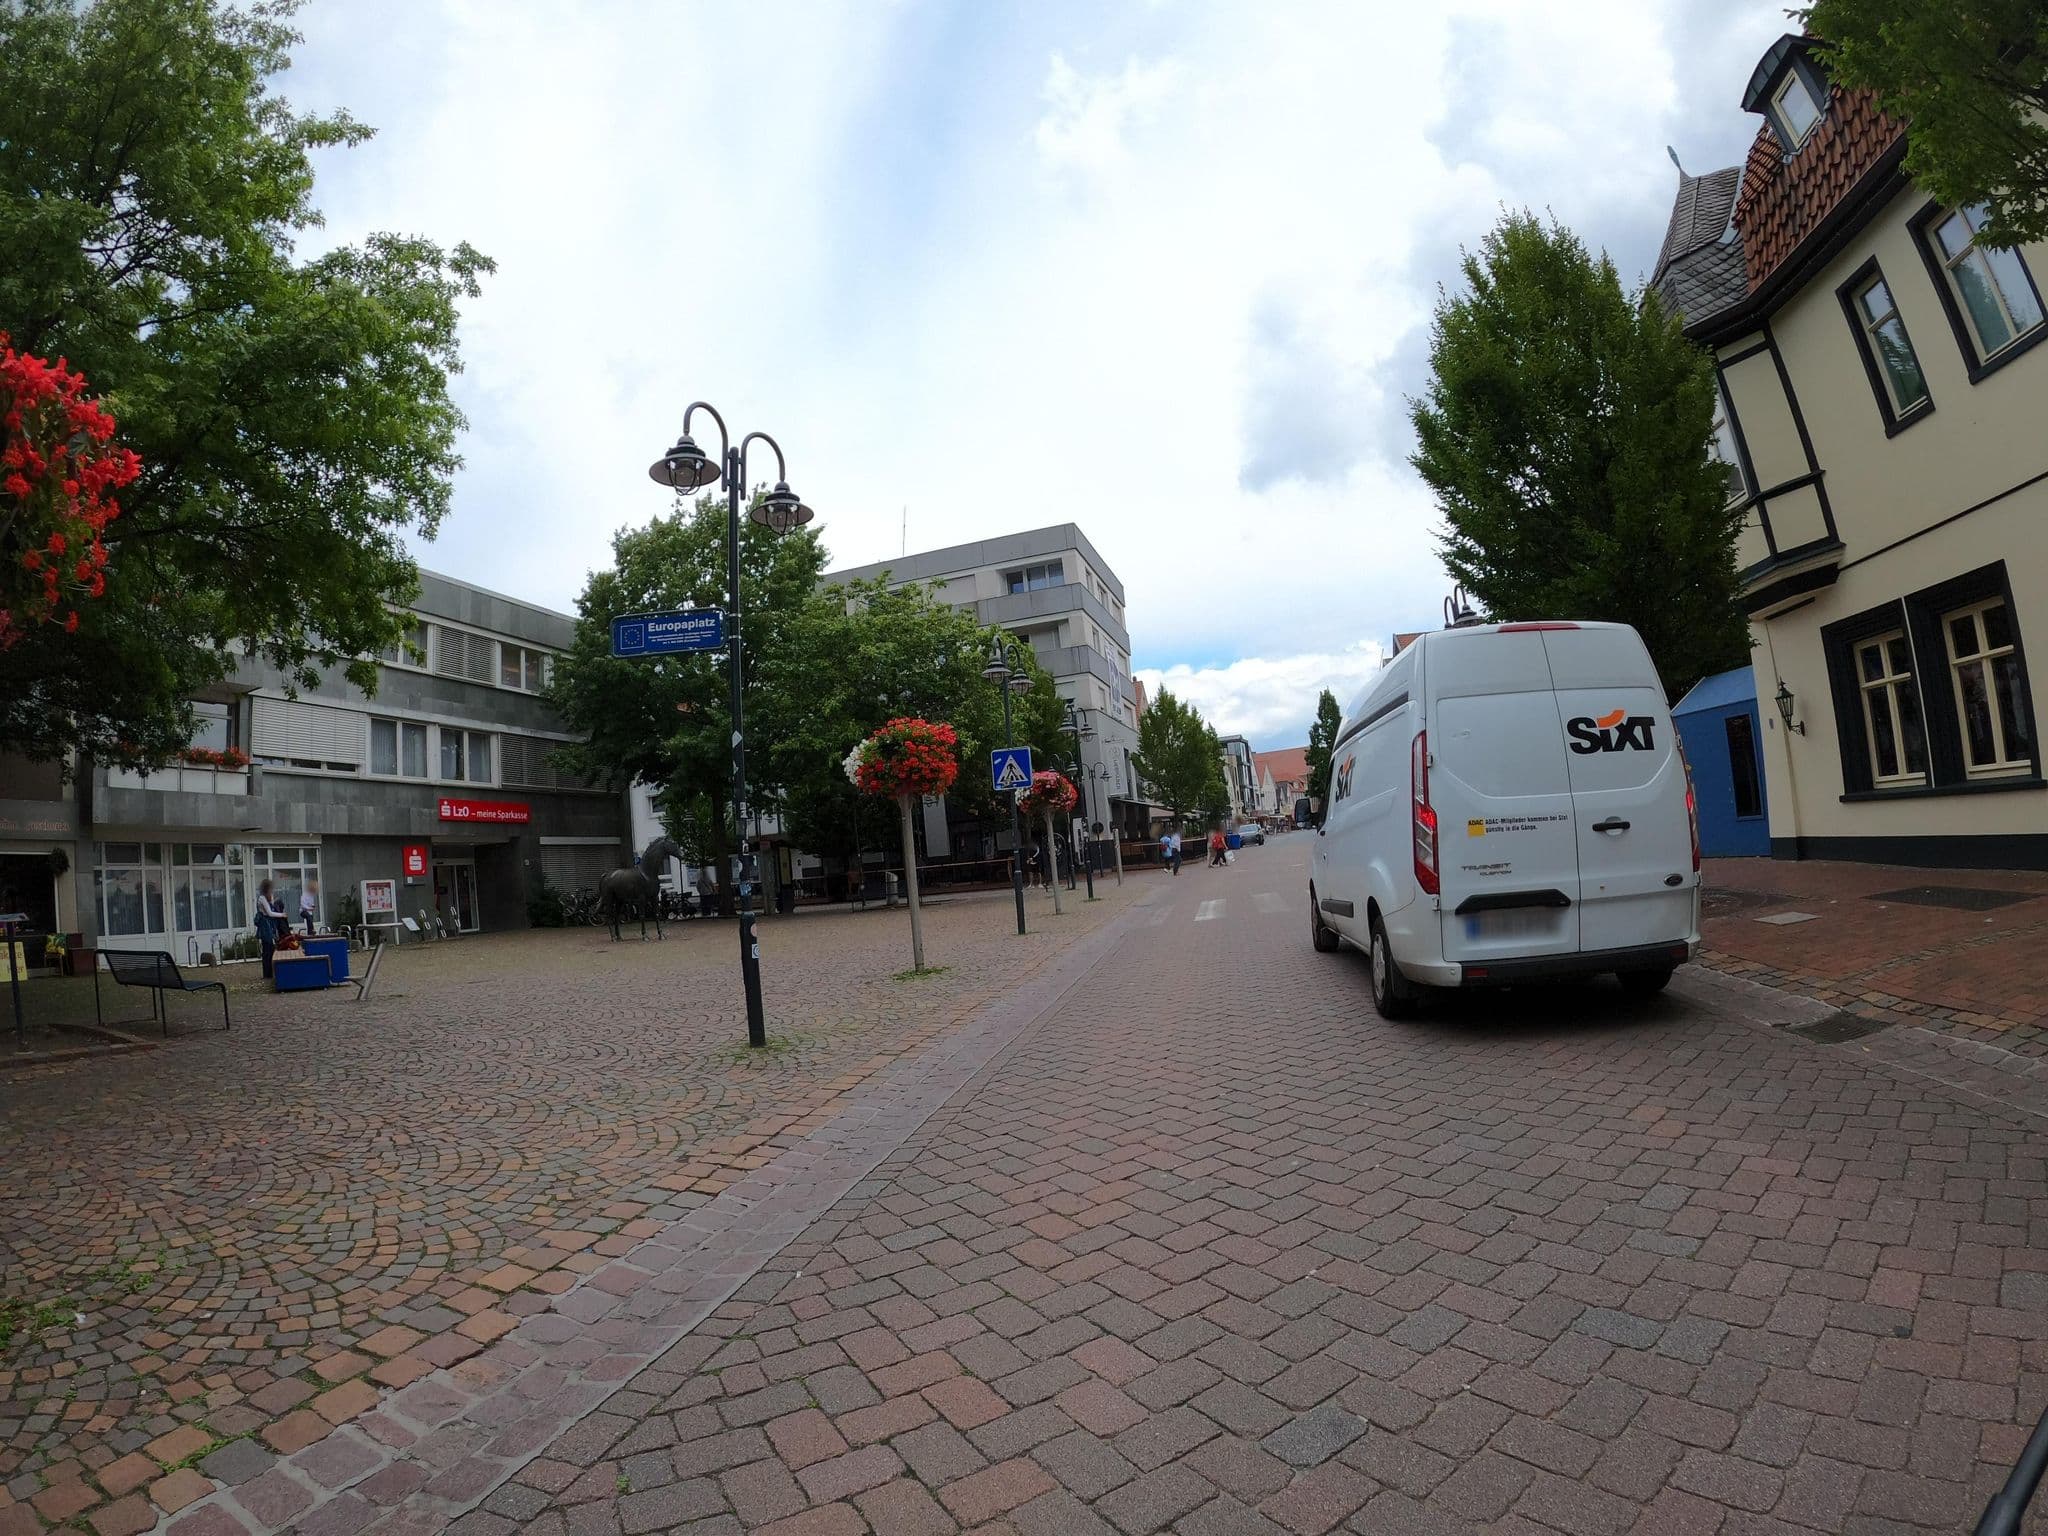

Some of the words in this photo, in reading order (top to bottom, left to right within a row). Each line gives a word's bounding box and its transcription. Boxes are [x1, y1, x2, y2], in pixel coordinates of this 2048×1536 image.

[647, 618, 716, 632] Europaplatz
[453, 806, 469, 817] LzO
[476, 810, 497, 819] meine
[497, 810, 528, 820] Sparkasse
